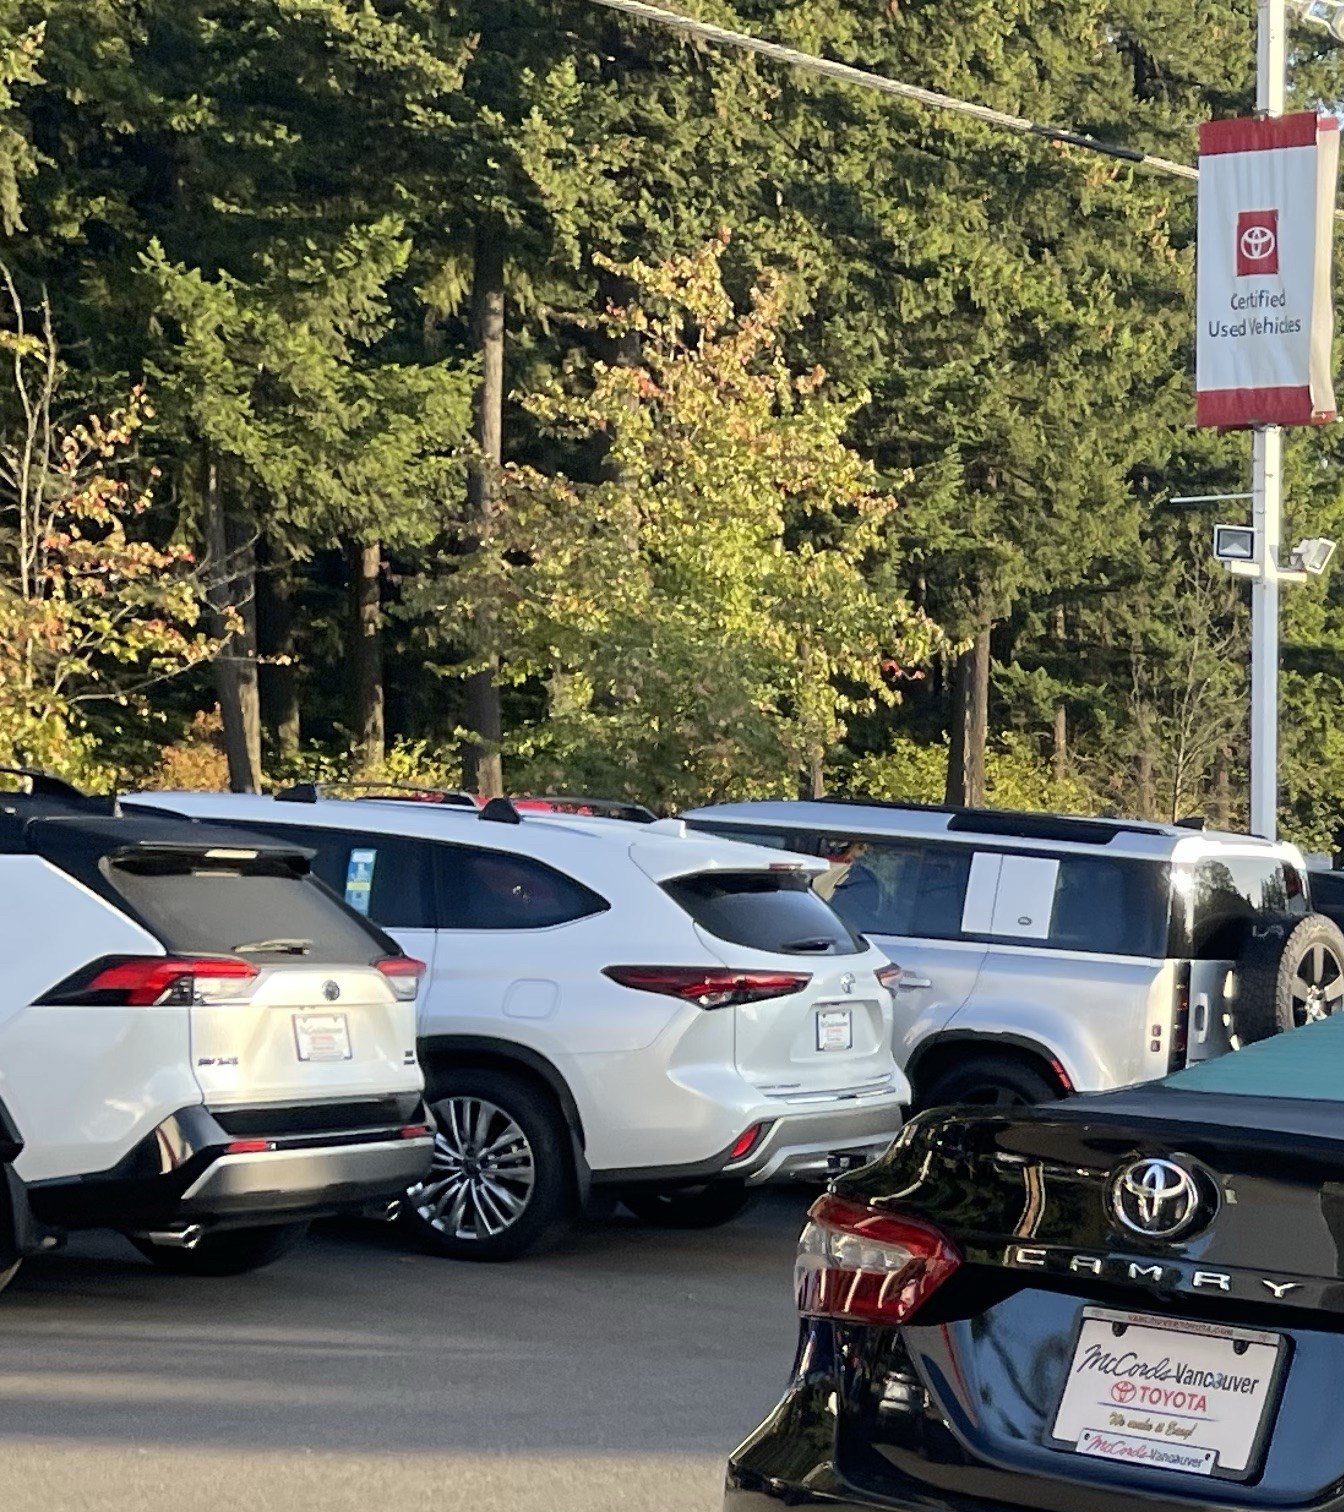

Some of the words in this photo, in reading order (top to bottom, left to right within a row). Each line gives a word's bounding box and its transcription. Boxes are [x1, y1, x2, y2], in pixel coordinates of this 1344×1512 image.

[1231, 289, 1286, 310] Certified
[1208, 318, 1247, 338] Used
[1248, 316, 1302, 335] Vehicles
[1016, 1248, 1303, 1299] CAMRY
[1140, 1385, 1208, 1413] TOYOTA
